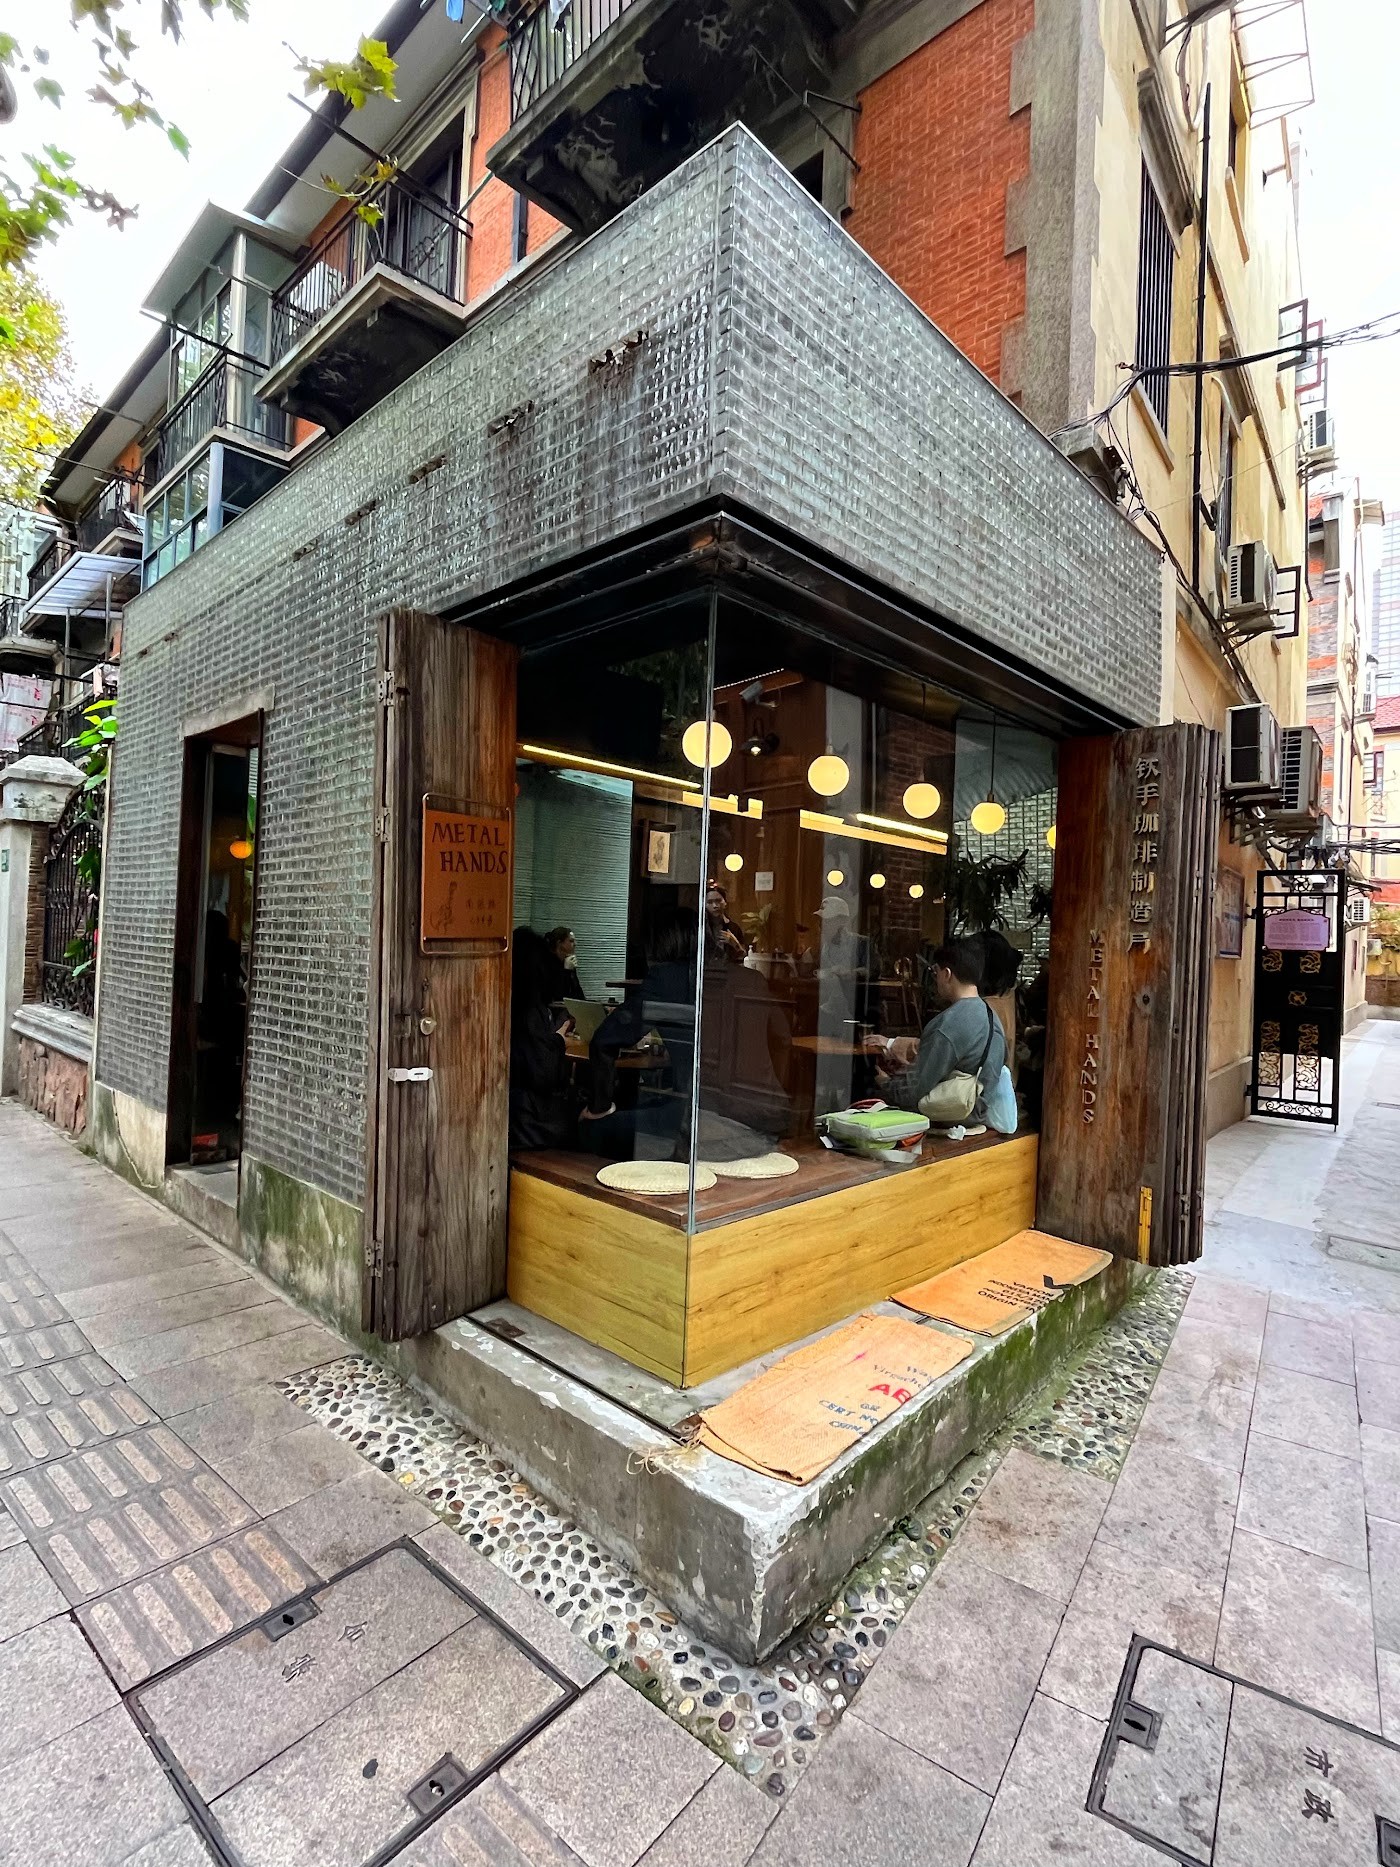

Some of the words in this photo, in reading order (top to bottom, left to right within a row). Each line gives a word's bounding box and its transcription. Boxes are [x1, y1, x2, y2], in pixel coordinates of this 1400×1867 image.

[432, 822, 505, 846] METAL
[440, 850, 508, 875] HANDS
[1087, 929, 1103, 1018] METAL
[1080, 1033, 1099, 1124] HANDS
[978, 1290, 1018, 1306] ORIGIN
